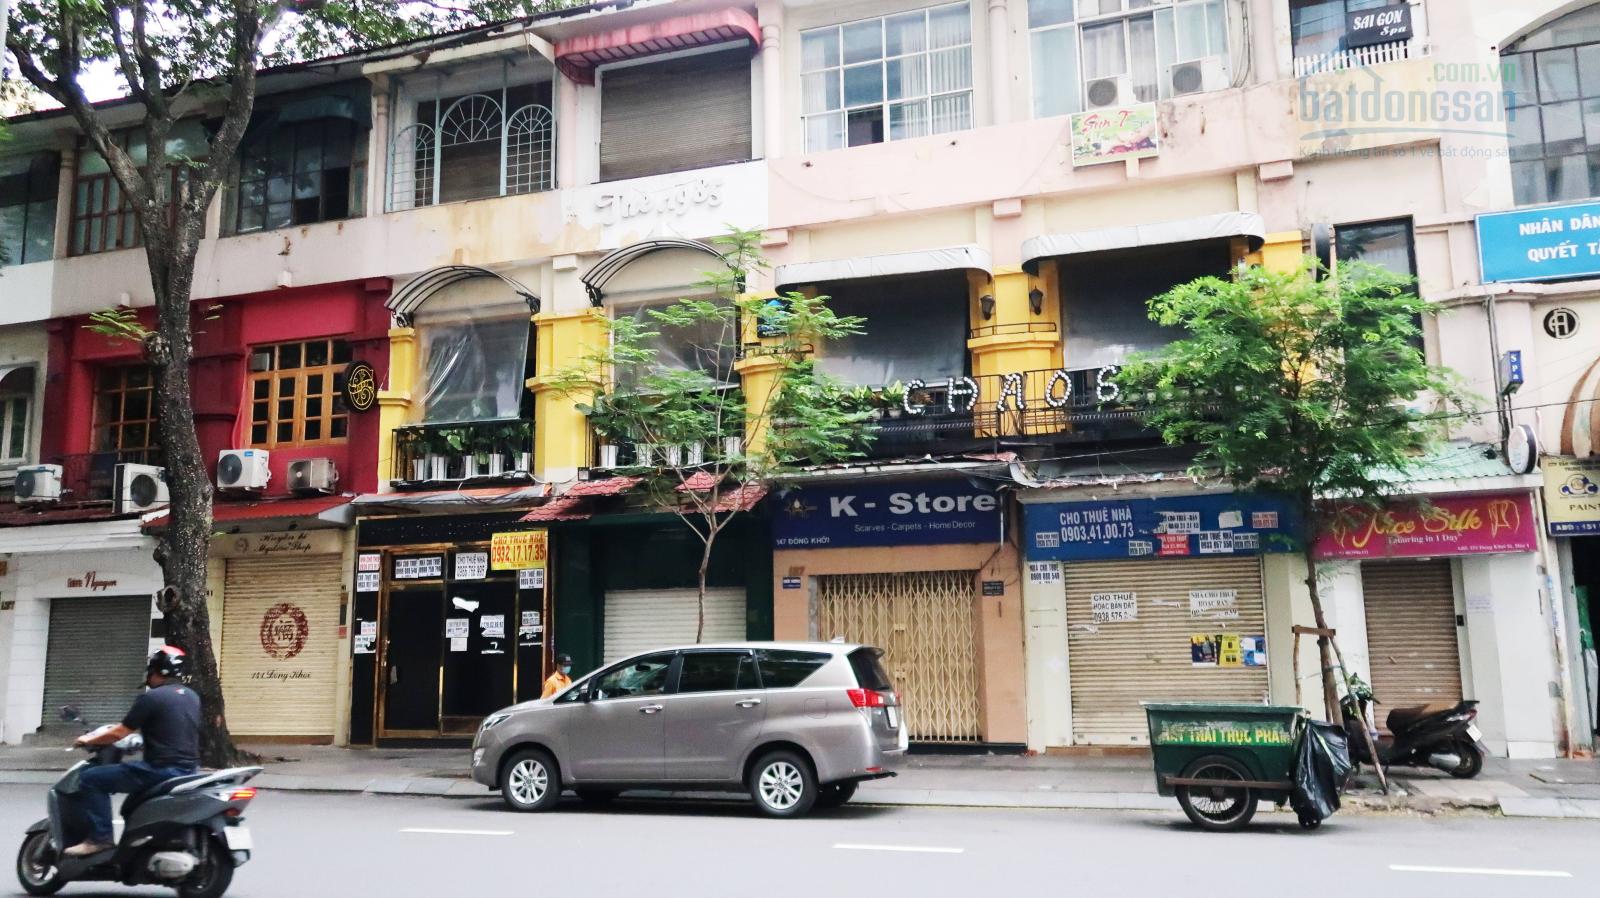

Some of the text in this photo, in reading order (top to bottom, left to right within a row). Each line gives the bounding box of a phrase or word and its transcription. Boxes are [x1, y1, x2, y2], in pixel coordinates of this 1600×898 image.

[1353, 9, 1404, 31] SAI GON
[1380, 23, 1407, 36] Spa
[1519, 217, 1564, 236] NHÂN
[1528, 239, 1600, 262] QUYẾT T
[829, 495, 859, 518] K
[889, 491, 997, 515] Store
[1060, 511, 1081, 526] CHO
[1083, 506, 1109, 524] THUÊ
[1420, 505, 1483, 534] Silk
[854, 523, 886, 533] Scarves
[891, 521, 923, 533] Carpets
[1425, 535, 1434, 543] in
[1094, 594, 1111, 602] CHO
